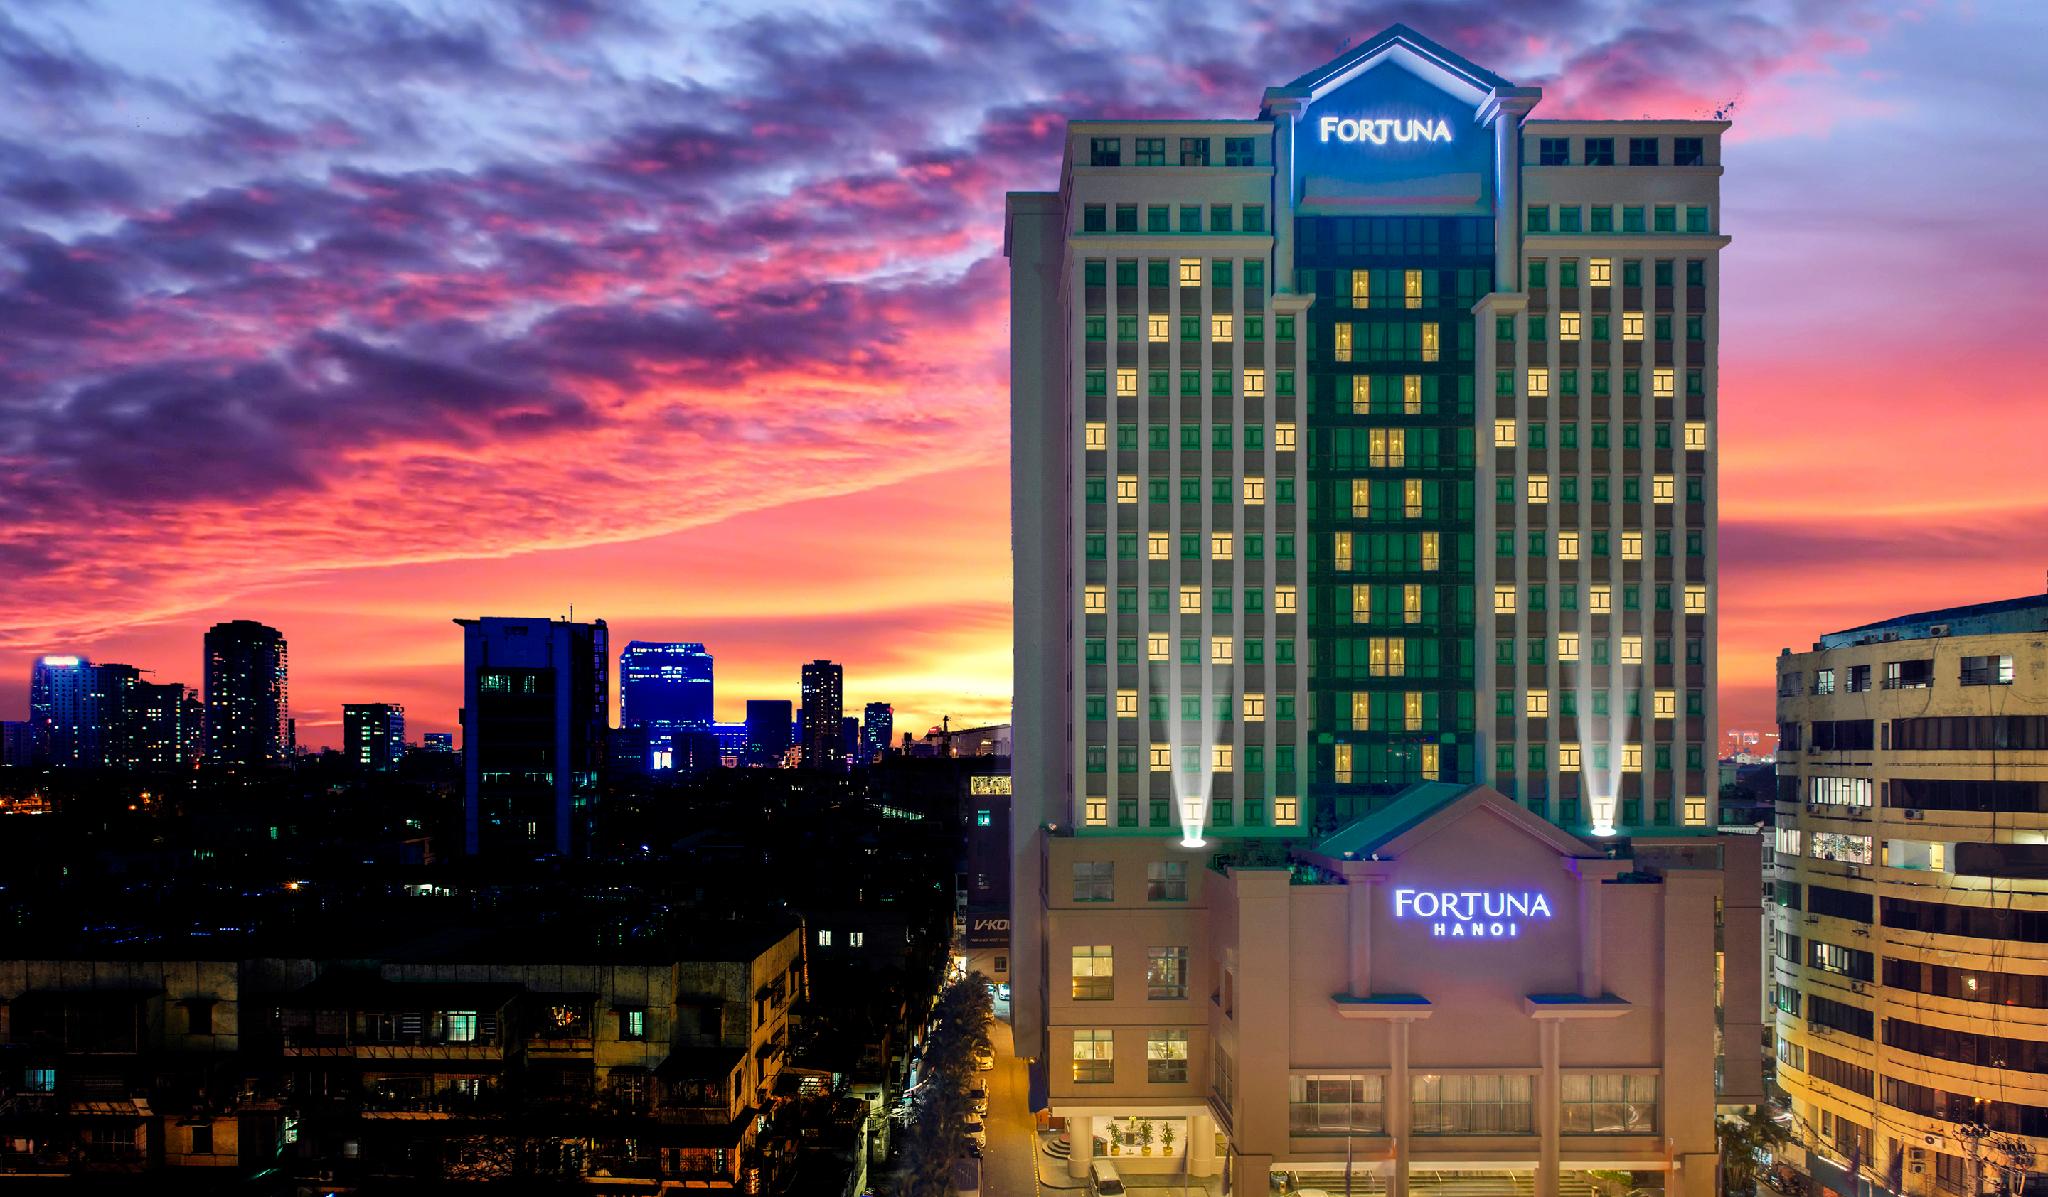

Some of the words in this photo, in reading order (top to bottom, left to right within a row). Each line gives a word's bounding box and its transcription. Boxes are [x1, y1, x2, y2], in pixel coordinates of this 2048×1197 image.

[1320, 117, 1452, 144] FORTUNA
[1395, 889, 1551, 921] FORTUNA
[1433, 923, 1516, 936] HANOI
